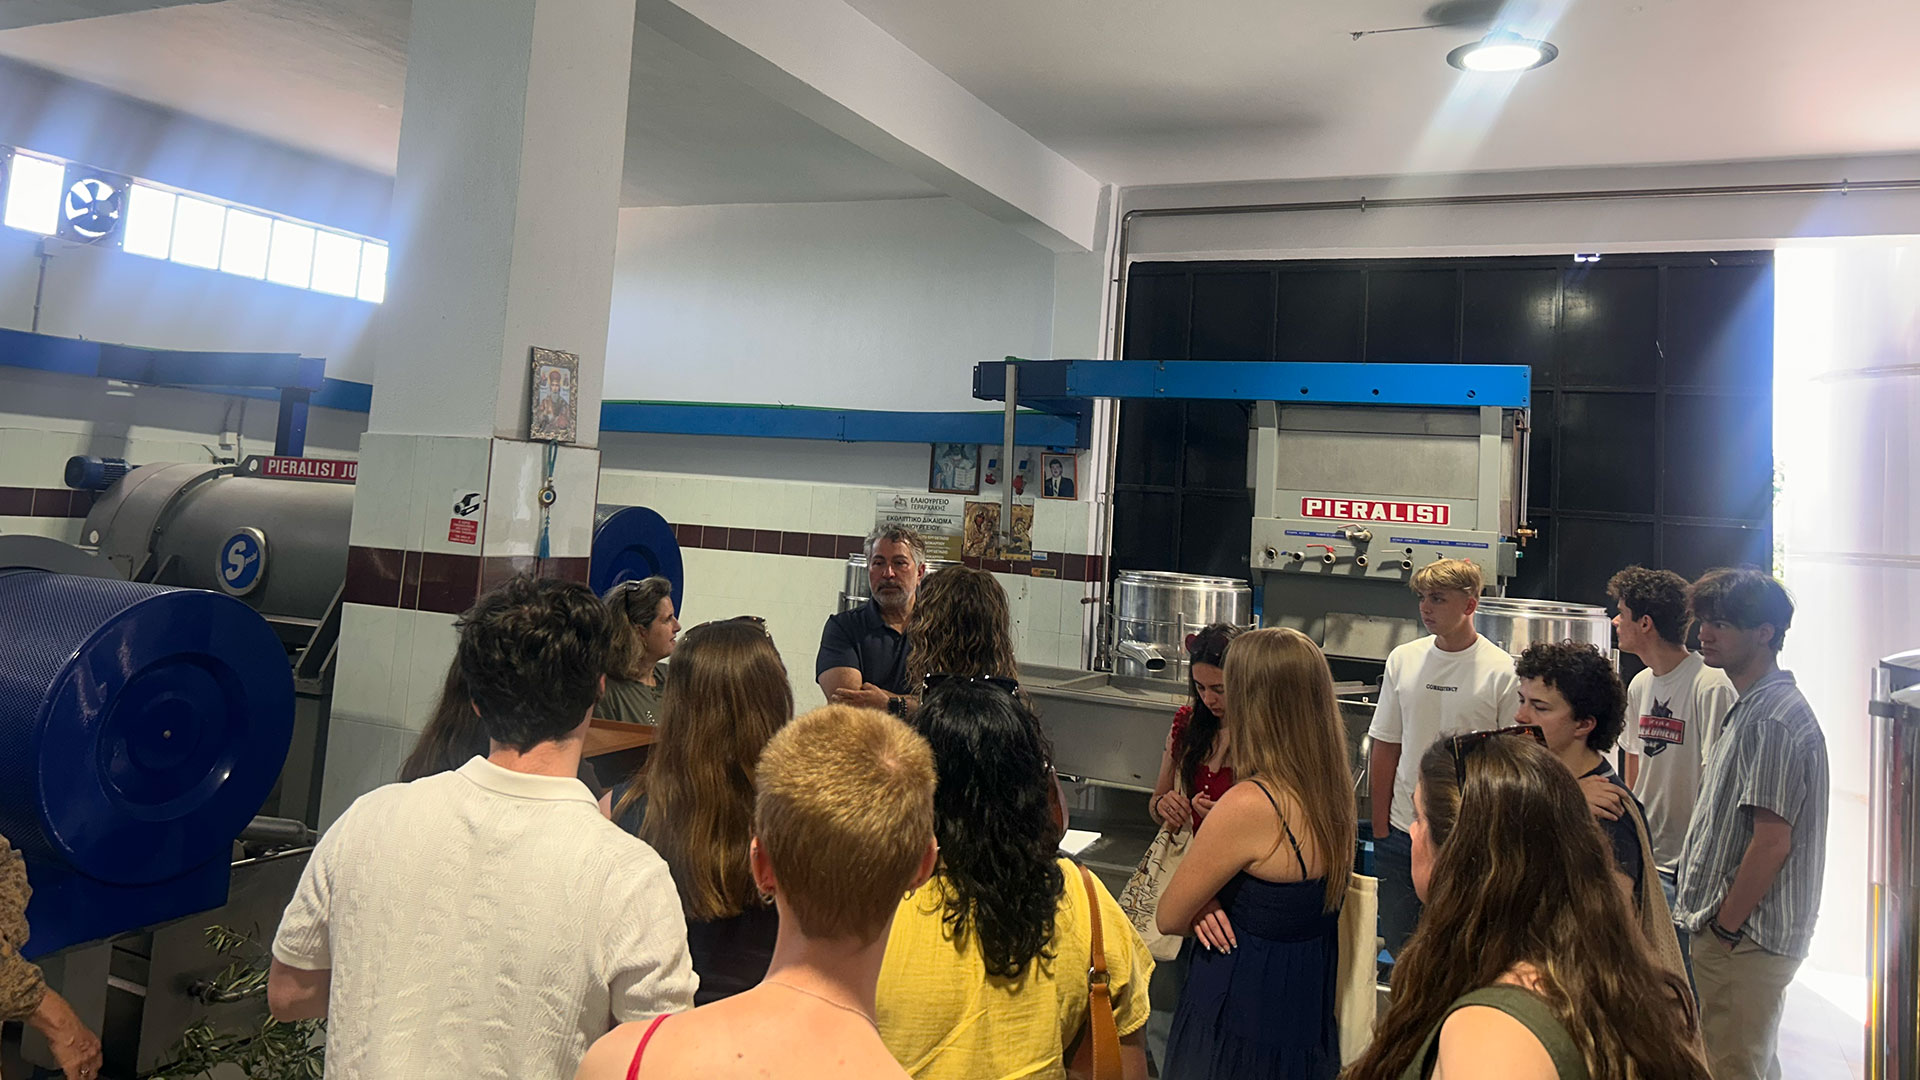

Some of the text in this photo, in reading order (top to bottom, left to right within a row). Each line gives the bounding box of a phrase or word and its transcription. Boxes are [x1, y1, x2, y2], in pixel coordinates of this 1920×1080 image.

[267, 459, 336, 477] PIERALISI
[910, 496, 950, 506] ΕΛΑΙΟΥΡΓΕΙΟ
[1306, 499, 1444, 524] PIERALISI
[922, 516, 953, 525] ΔΙΚΑΙΩΜΑ
